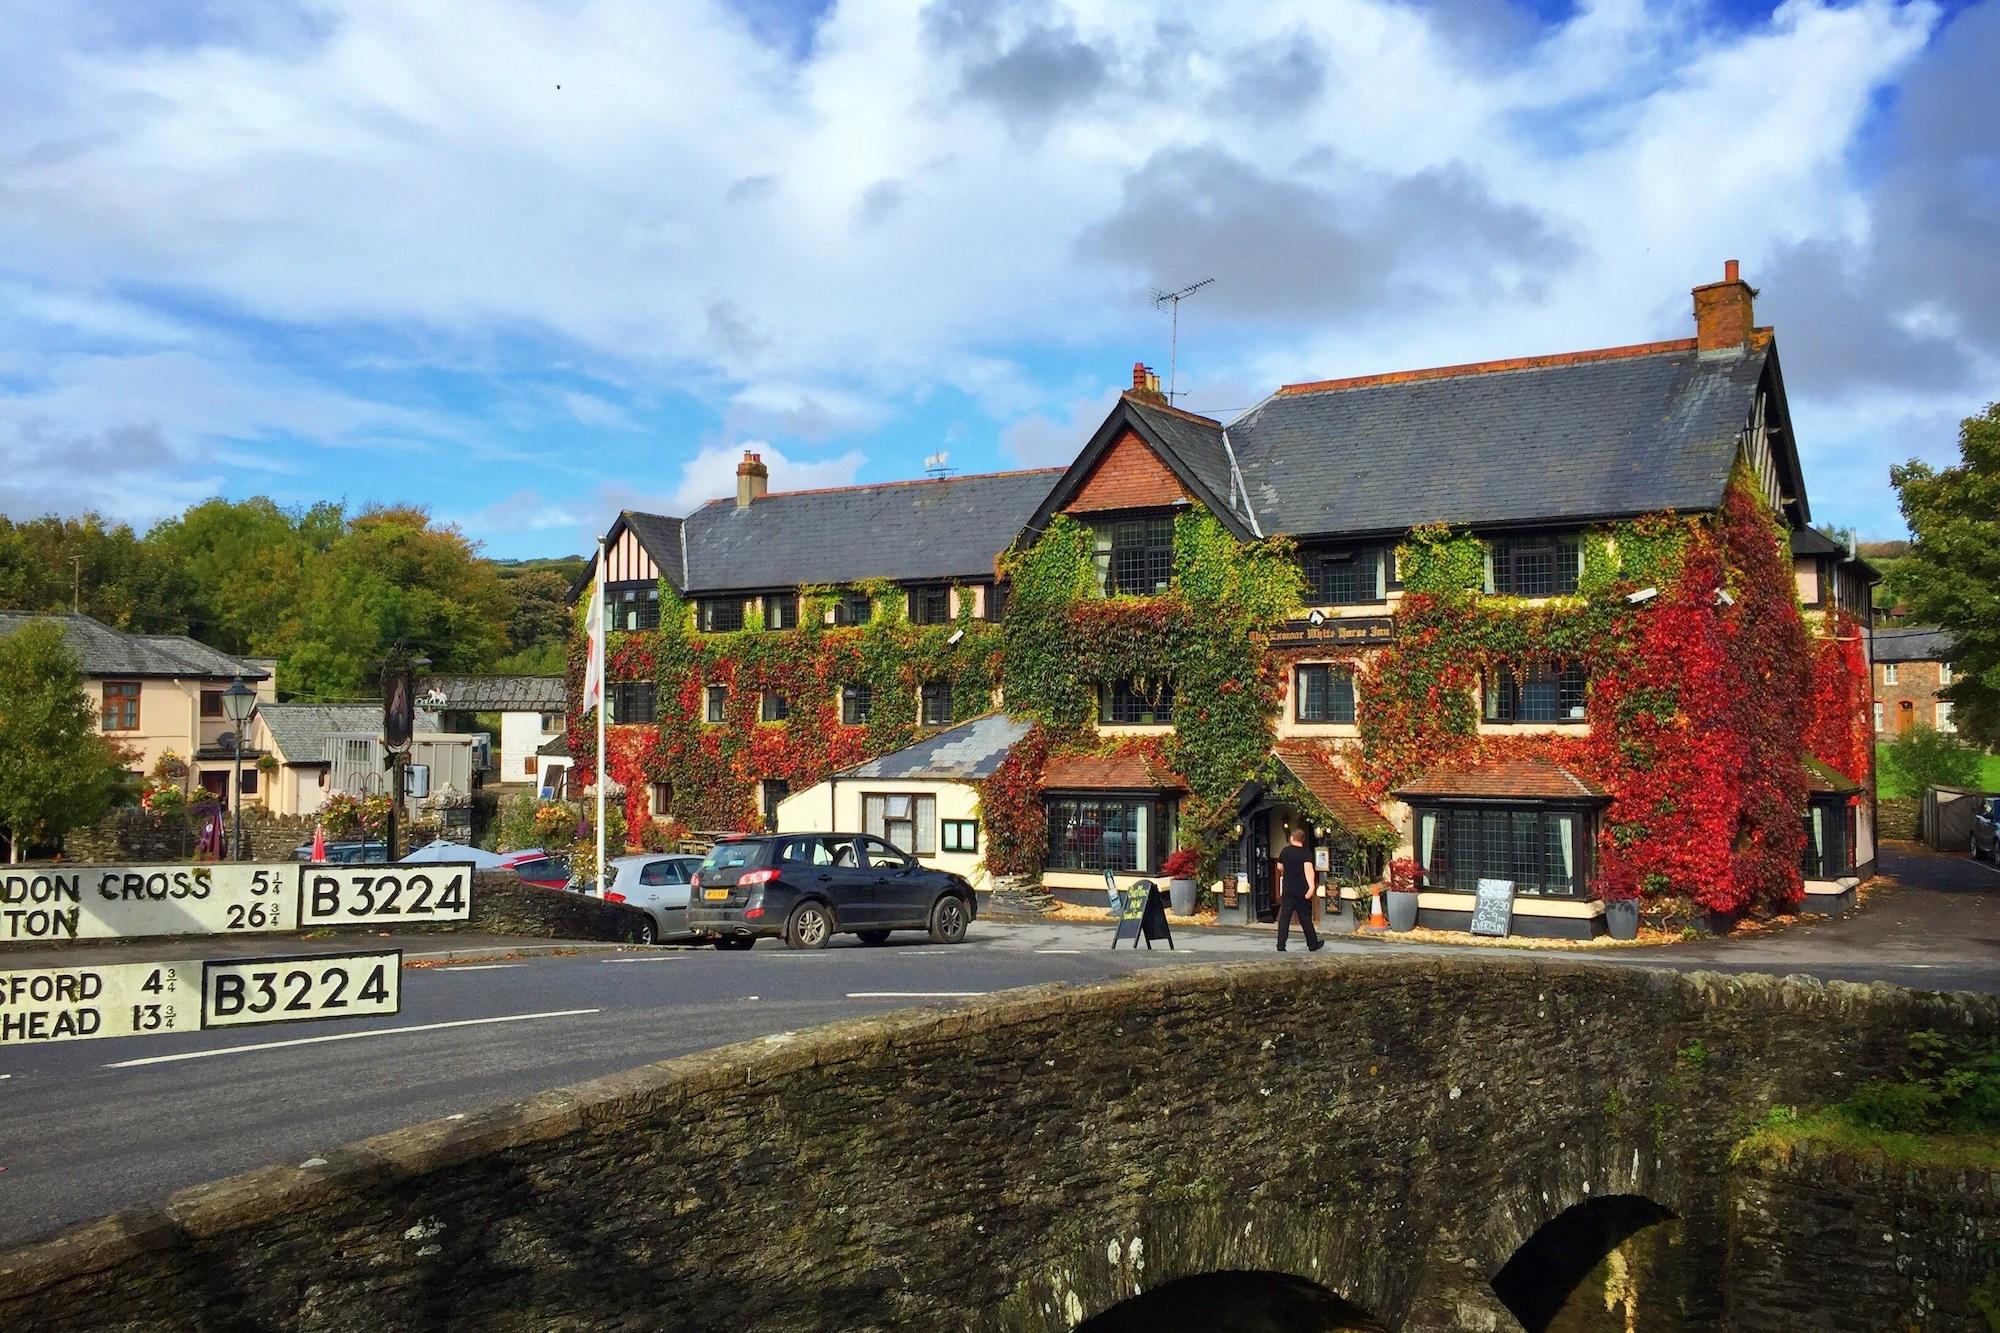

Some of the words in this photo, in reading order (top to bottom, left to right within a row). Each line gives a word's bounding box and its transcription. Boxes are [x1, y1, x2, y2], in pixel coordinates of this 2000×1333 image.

[1338, 626, 1366, 639] Horse
[0, 874, 80, 904] DON
[99, 871, 211, 900] CROSS
[4, 908, 79, 938] TON
[214, 964, 389, 1017] B3224
[3, 1008, 100, 1040] HEAD
